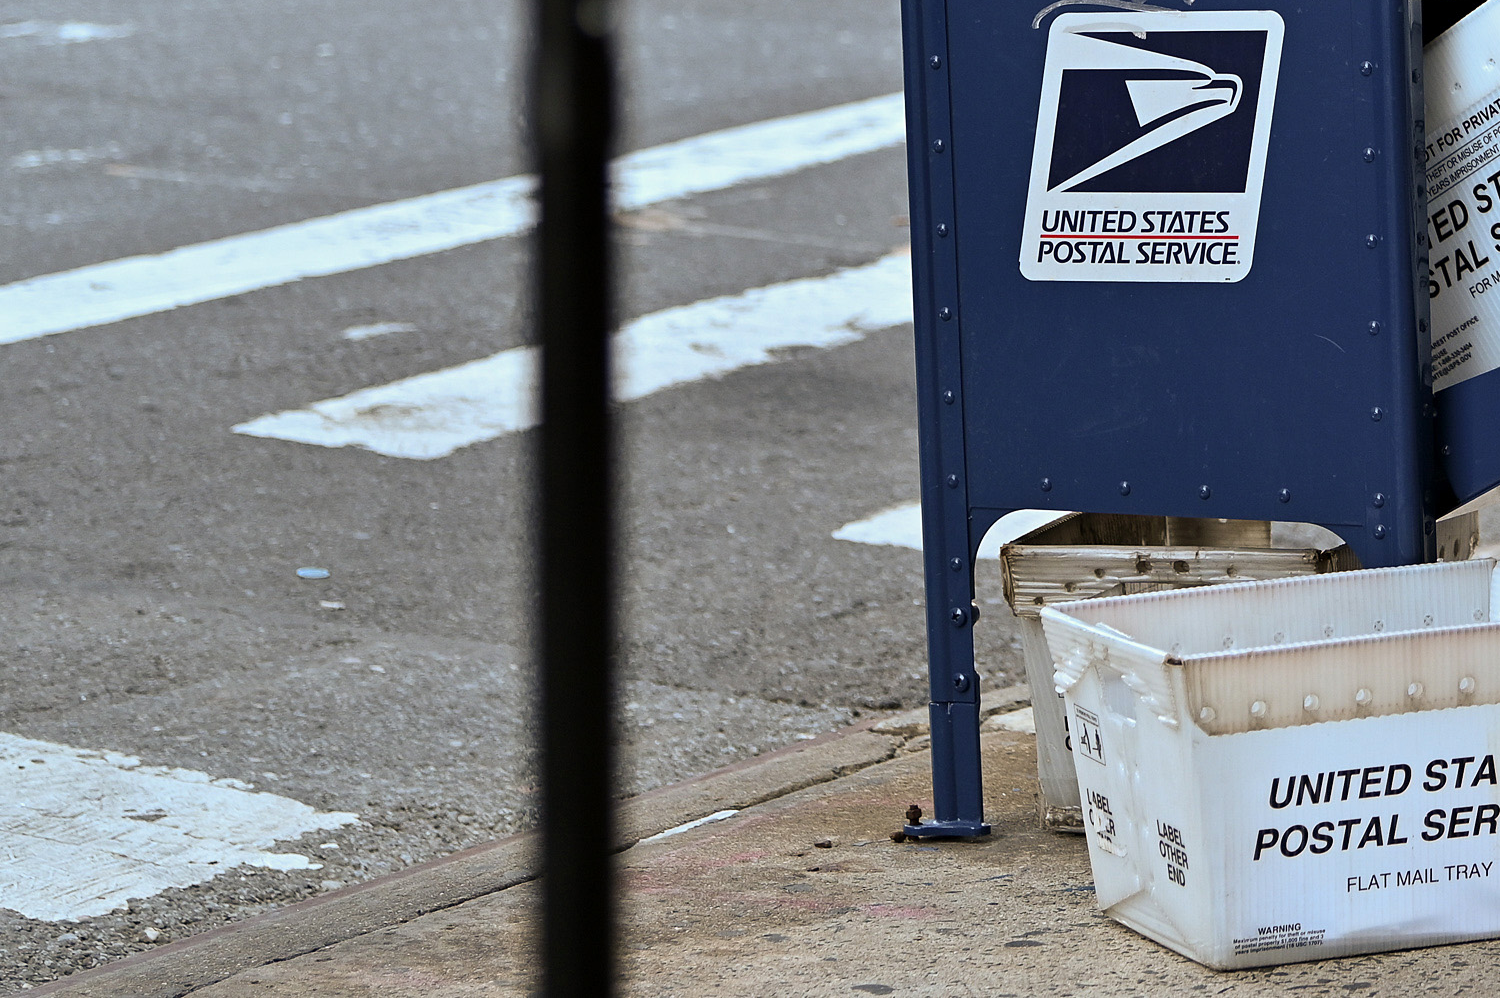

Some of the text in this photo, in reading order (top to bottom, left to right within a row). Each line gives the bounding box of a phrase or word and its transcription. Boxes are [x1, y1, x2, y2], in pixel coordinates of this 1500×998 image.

[1436, 128, 1464, 152] FOR
[1426, 163, 1447, 184] THEFT
[1446, 157, 1459, 169] OR
[1458, 140, 1484, 162] MISUSE
[1483, 132, 1494, 145] OF
[1426, 177, 1451, 198] YEARS
[1041, 209, 1230, 234] UNITED STATES
[1036, 240, 1131, 264] POSTAL
[1468, 278, 1493, 298] FOR
[1446, 327, 1461, 340] POST
[1460, 315, 1480, 331] OFFICE
[1268, 763, 1413, 810] UNITED
[1086, 787, 1113, 816] LABEL
[1156, 818, 1186, 849] LABEL
[1252, 814, 1409, 862] POSTAL
[1159, 839, 1189, 870] OTHER
[1167, 862, 1186, 887] END
[1347, 861, 1494, 893] FLAT MAIL TRAY
[1241, 940, 1258, 950] postal
[1258, 938, 1280, 948] property
[1309, 933, 1320, 941] and
[1257, 922, 1302, 936] WARNING
[1258, 933, 1278, 942] penalty
[1306, 928, 1326, 936] misuse
[1234, 948, 1249, 956] years
[1249, 943, 1286, 955] imprisonment
[1295, 940, 1307, 948] USC
